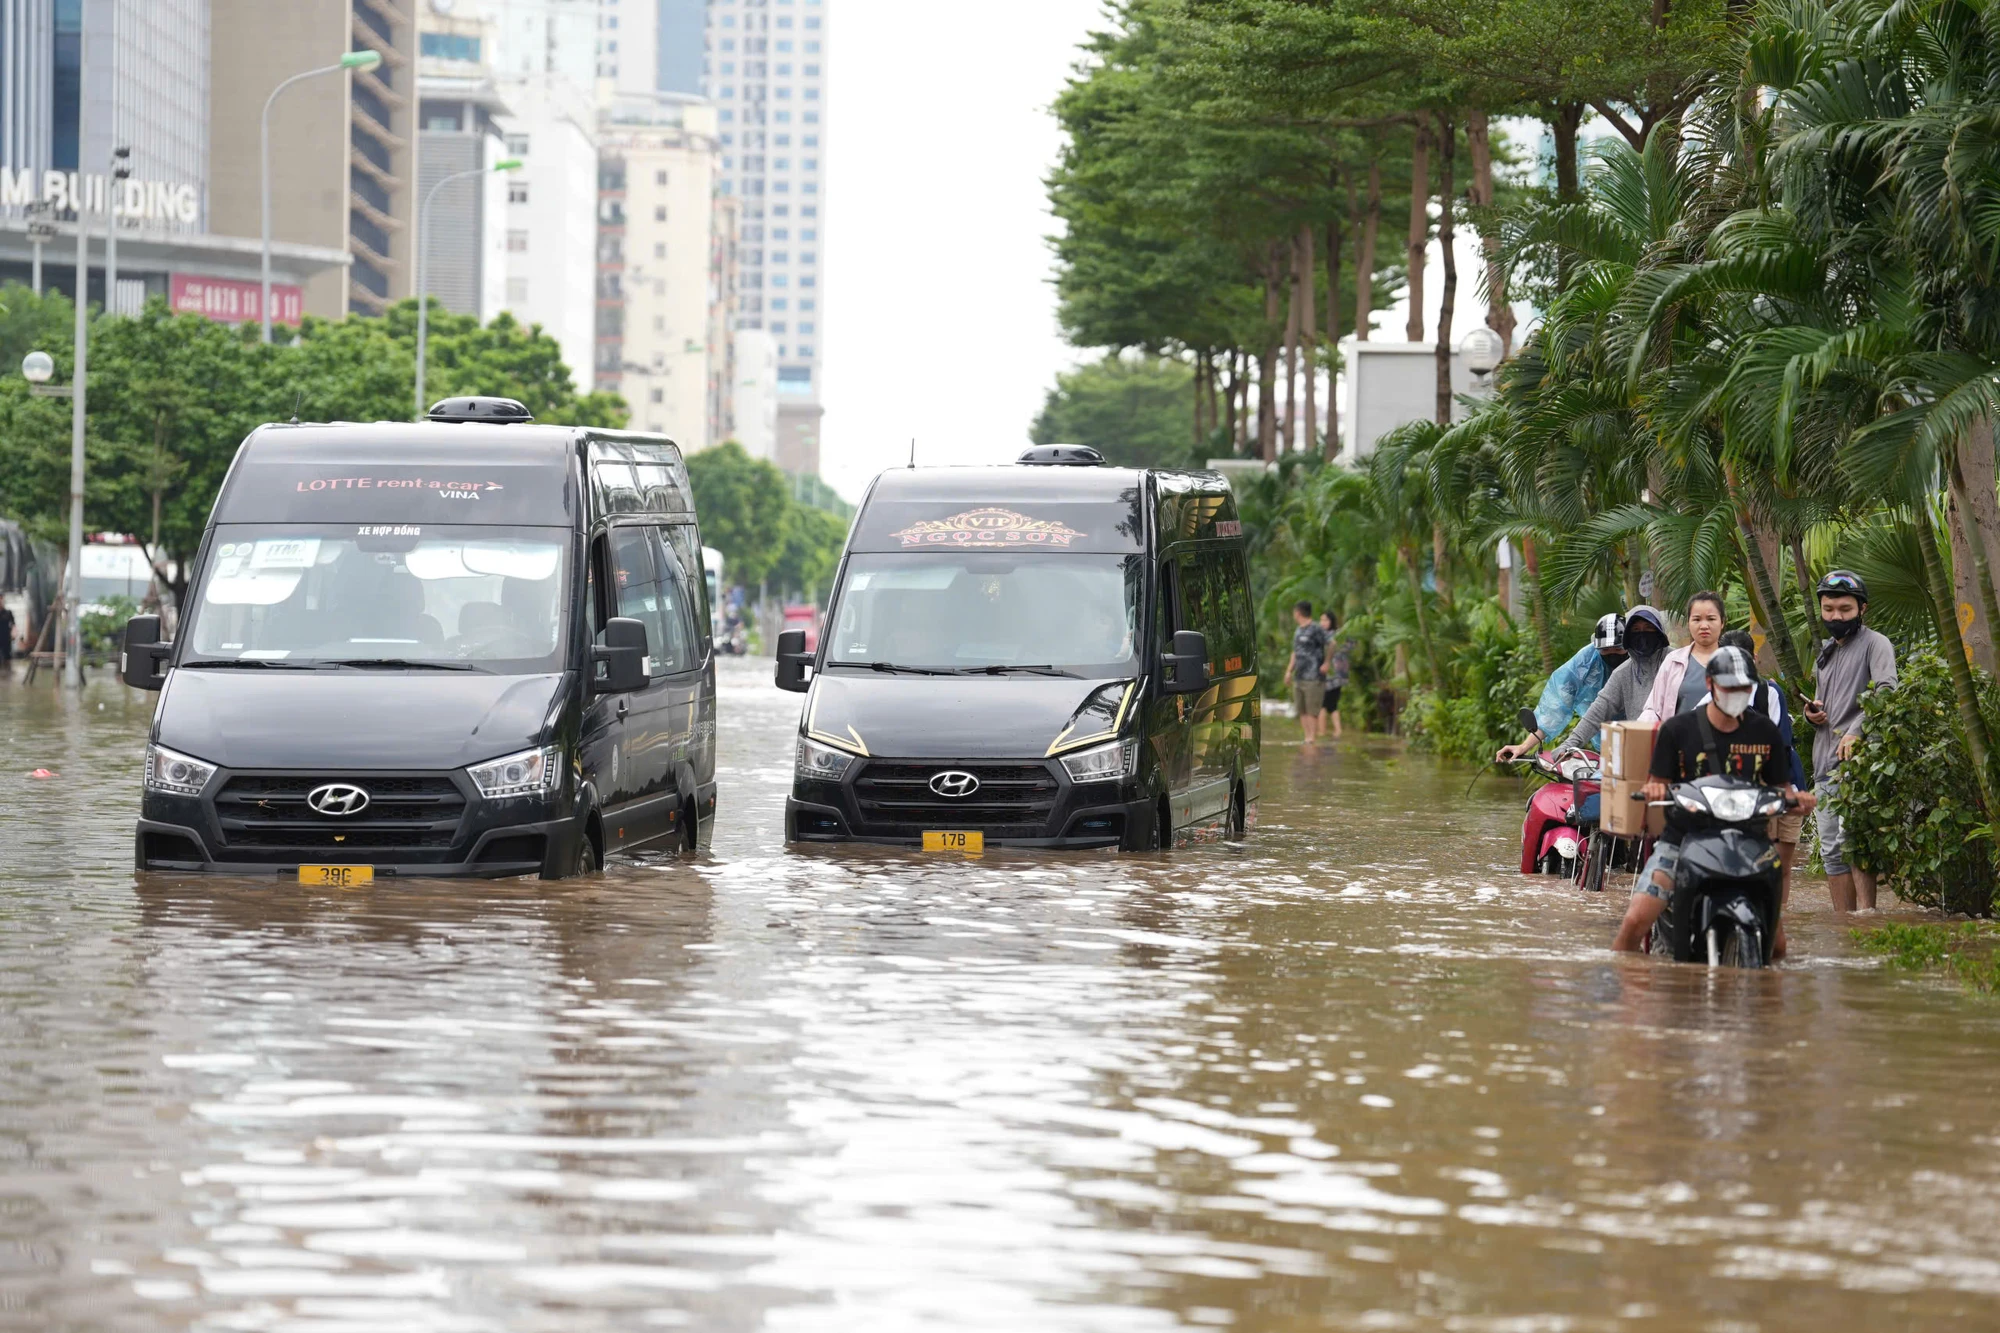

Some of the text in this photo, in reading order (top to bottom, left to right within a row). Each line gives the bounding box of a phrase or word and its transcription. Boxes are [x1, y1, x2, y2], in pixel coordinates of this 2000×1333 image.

[296, 478, 372, 492] LOTTE
[439, 490, 480, 500] VINA
[970, 517, 1010, 527] VIP
[357, 526, 371, 535] XE
[901, 531, 996, 544] NGỌC
[941, 833, 966, 846] 17B
